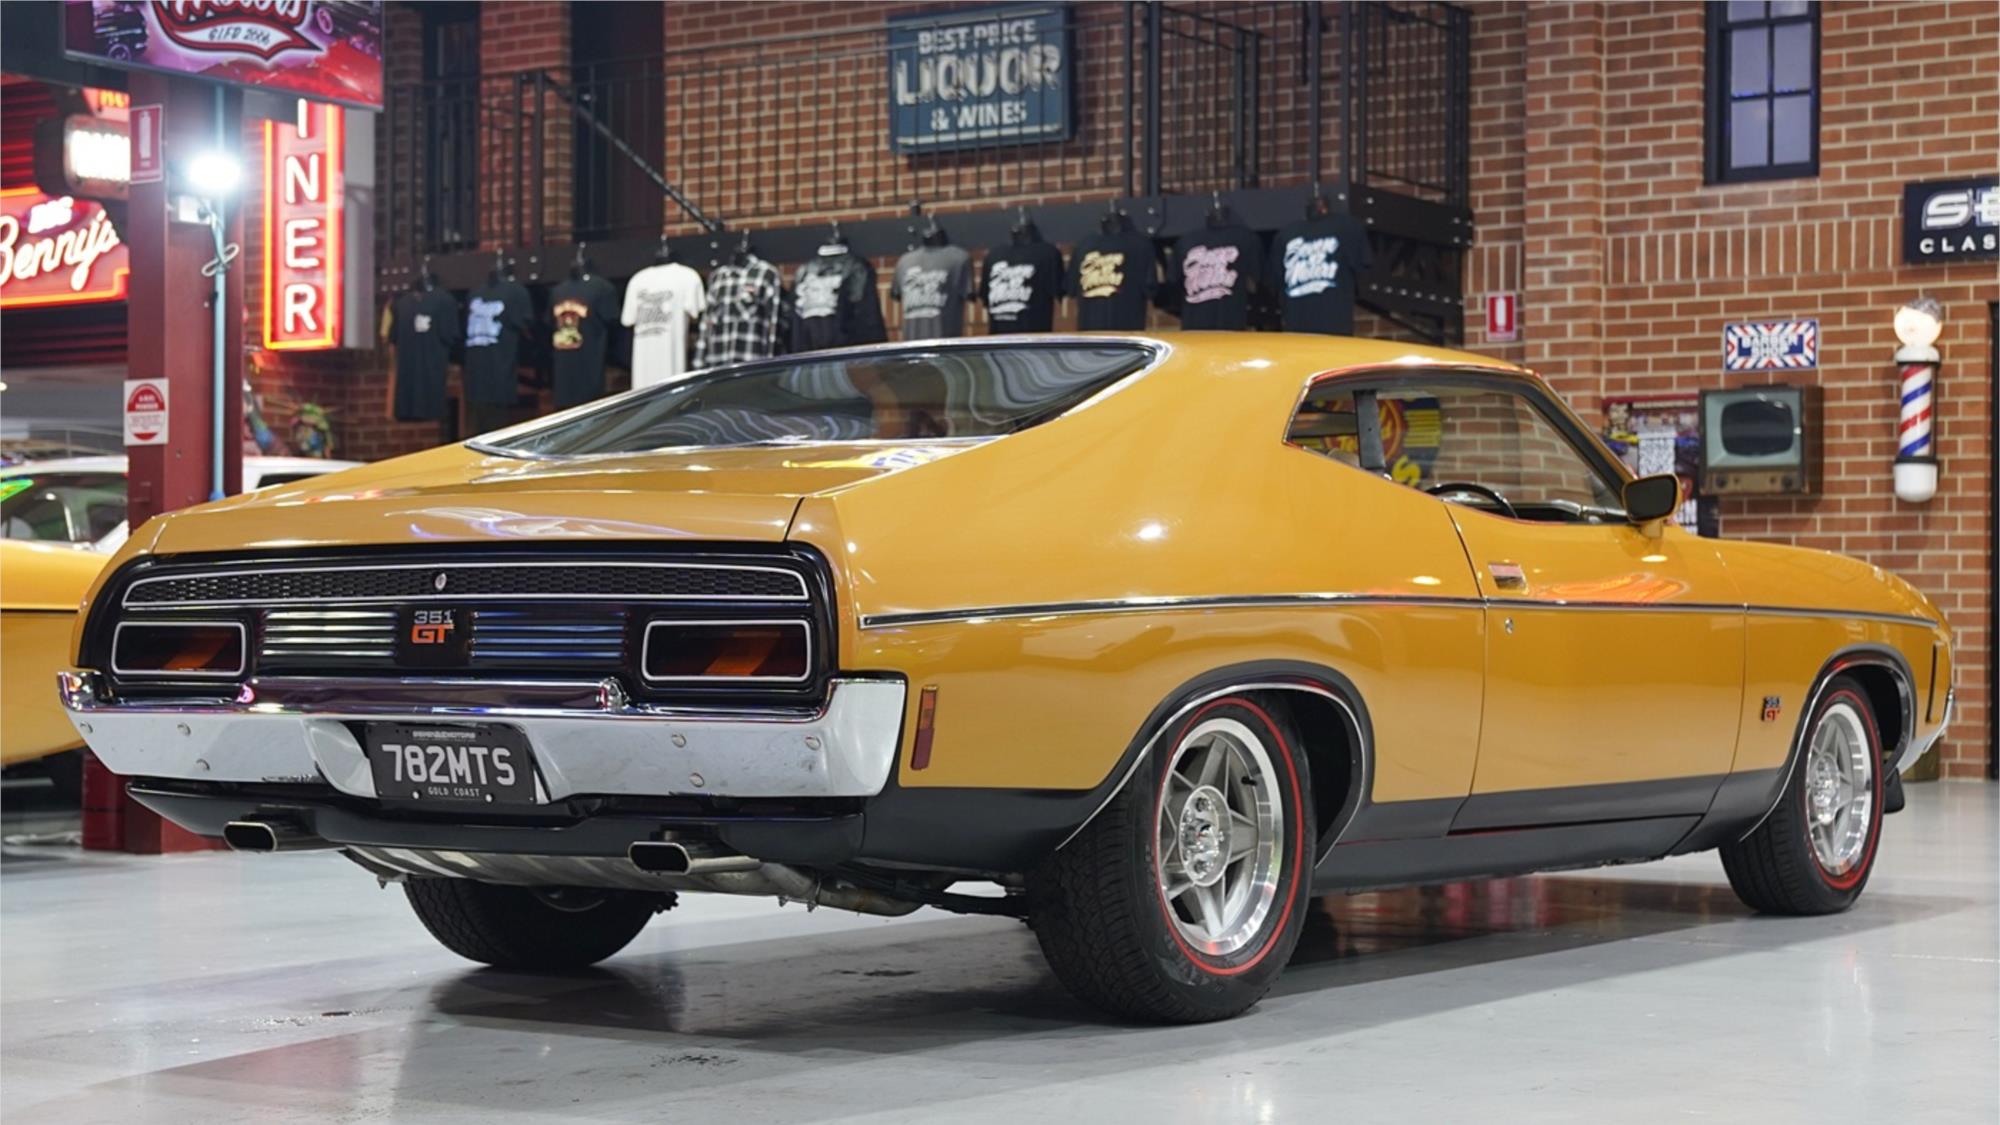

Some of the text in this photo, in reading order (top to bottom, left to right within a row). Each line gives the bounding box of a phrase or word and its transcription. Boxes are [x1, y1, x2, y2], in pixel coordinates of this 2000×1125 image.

[918, 19, 1038, 54] BEST PRICE
[897, 44, 1061, 105] LIQUOR
[930, 101, 1028, 131] & WINES
[1920, 233, 1997, 255] CLAS
[413, 609, 454, 624] 351
[412, 623, 454, 645] GT
[381, 744, 516, 786] 782MTS
[427, 786, 480, 798] GOLD COAST
